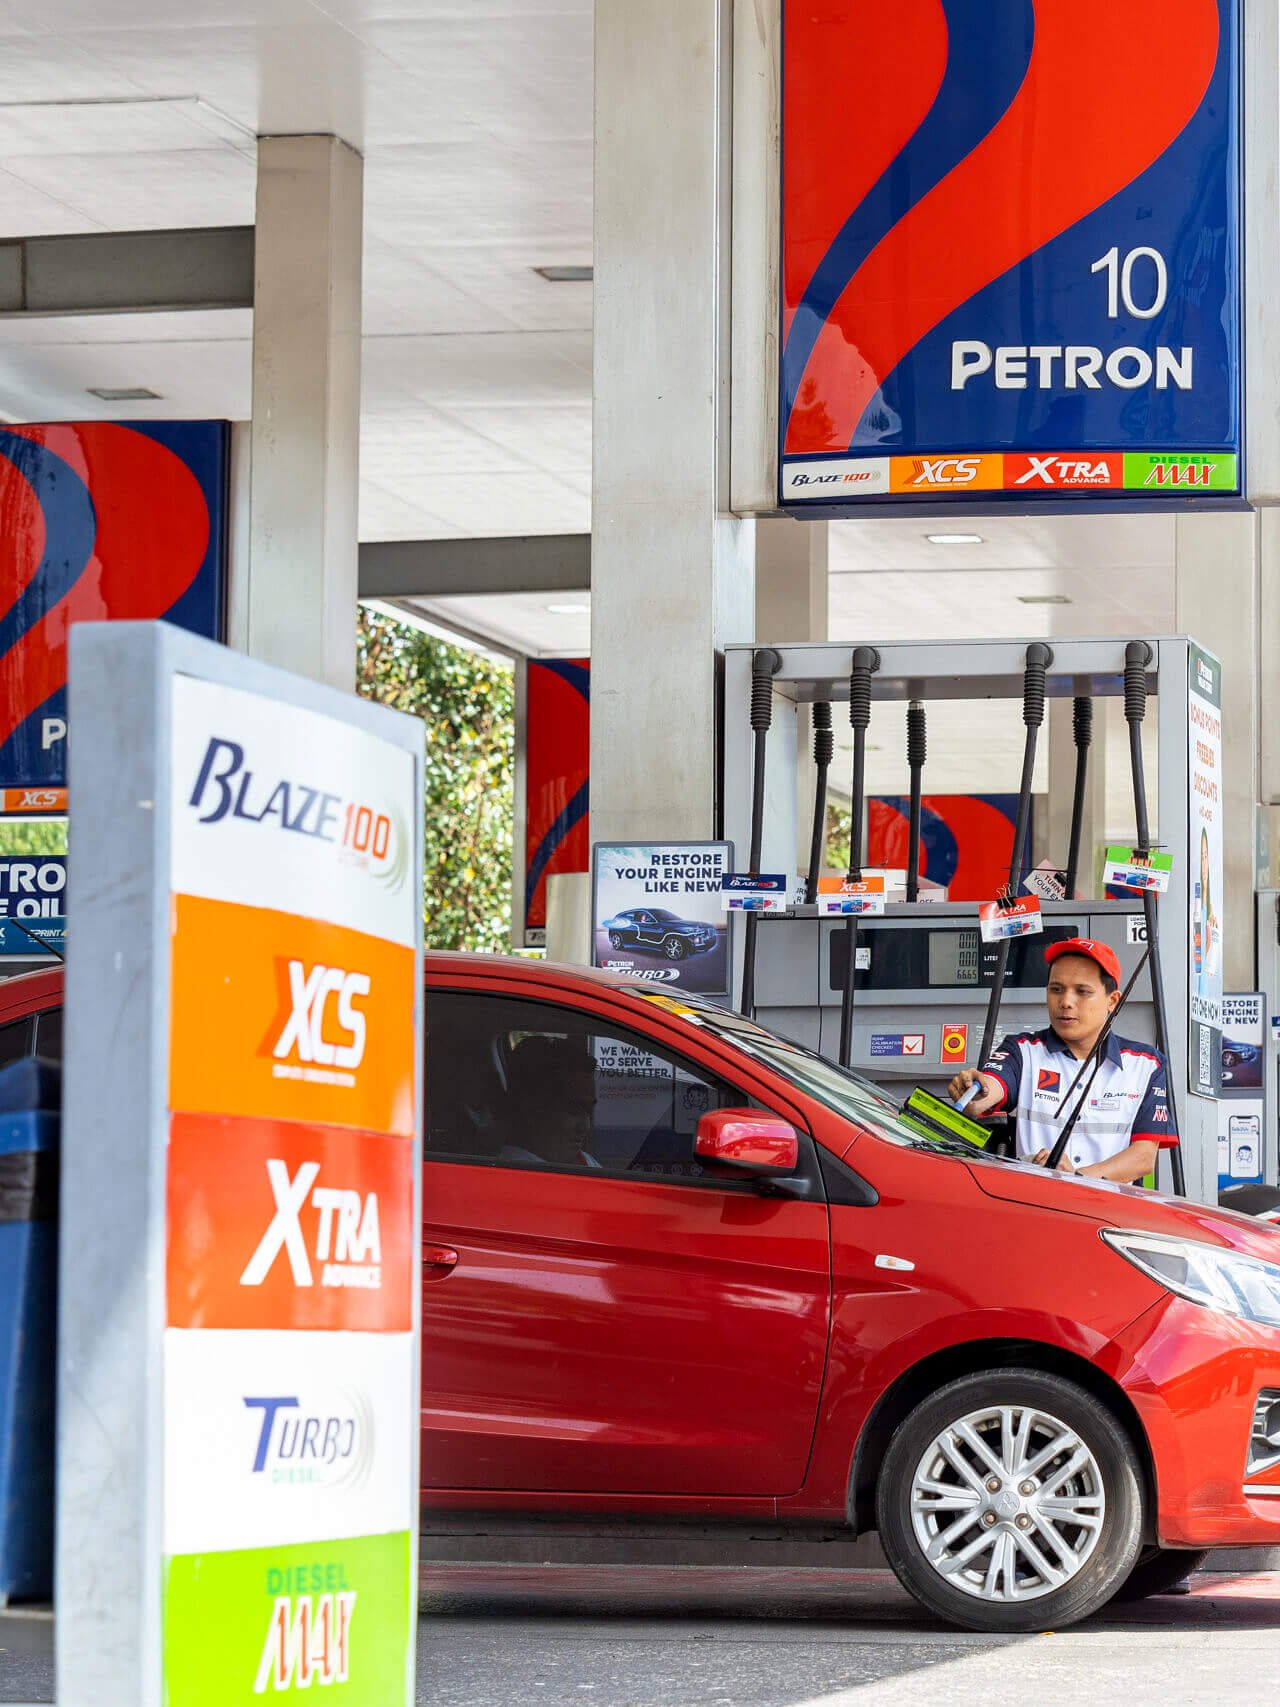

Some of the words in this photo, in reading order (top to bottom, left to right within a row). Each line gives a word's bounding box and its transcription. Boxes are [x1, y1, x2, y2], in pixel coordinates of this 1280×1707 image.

[1091, 246, 1168, 319] 10
[951, 340, 1193, 390] PETRON
[1149, 456, 1212, 464] DIESEL
[913, 459, 981, 483] XCS
[1014, 457, 1110, 484] XTRA
[1144, 464, 1216, 486] MAX
[20, 791, 60, 806] XCS
[651, 854, 722, 865] RESTORE
[615, 868, 658, 879] YOUR
[664, 868, 722, 878] ENGINE
[645, 881, 679, 892] LIKE
[685, 881, 722, 892] NEW
[1131, 927, 1148, 942] 10
[273, 959, 371, 1069] XCS
[1222, 1008, 1259, 1016] ENGINE
[1235, 1016, 1259, 1025] NEW
[600, 1046, 617, 1056] WE
[620, 1046, 651, 1056] WA
[600, 1057, 615, 1067] TO
[618, 1057, 652, 1067] SERVE
[600, 1068, 624, 1078] YOU
[627, 1068, 672, 1078] BETTER.
[1034, 1091, 1060, 1103] PETRON
[240, 1158, 382, 1288] XTRA
[243, 1396, 355, 1472] TURBO
[267, 1562, 350, 1596] DIESEL
